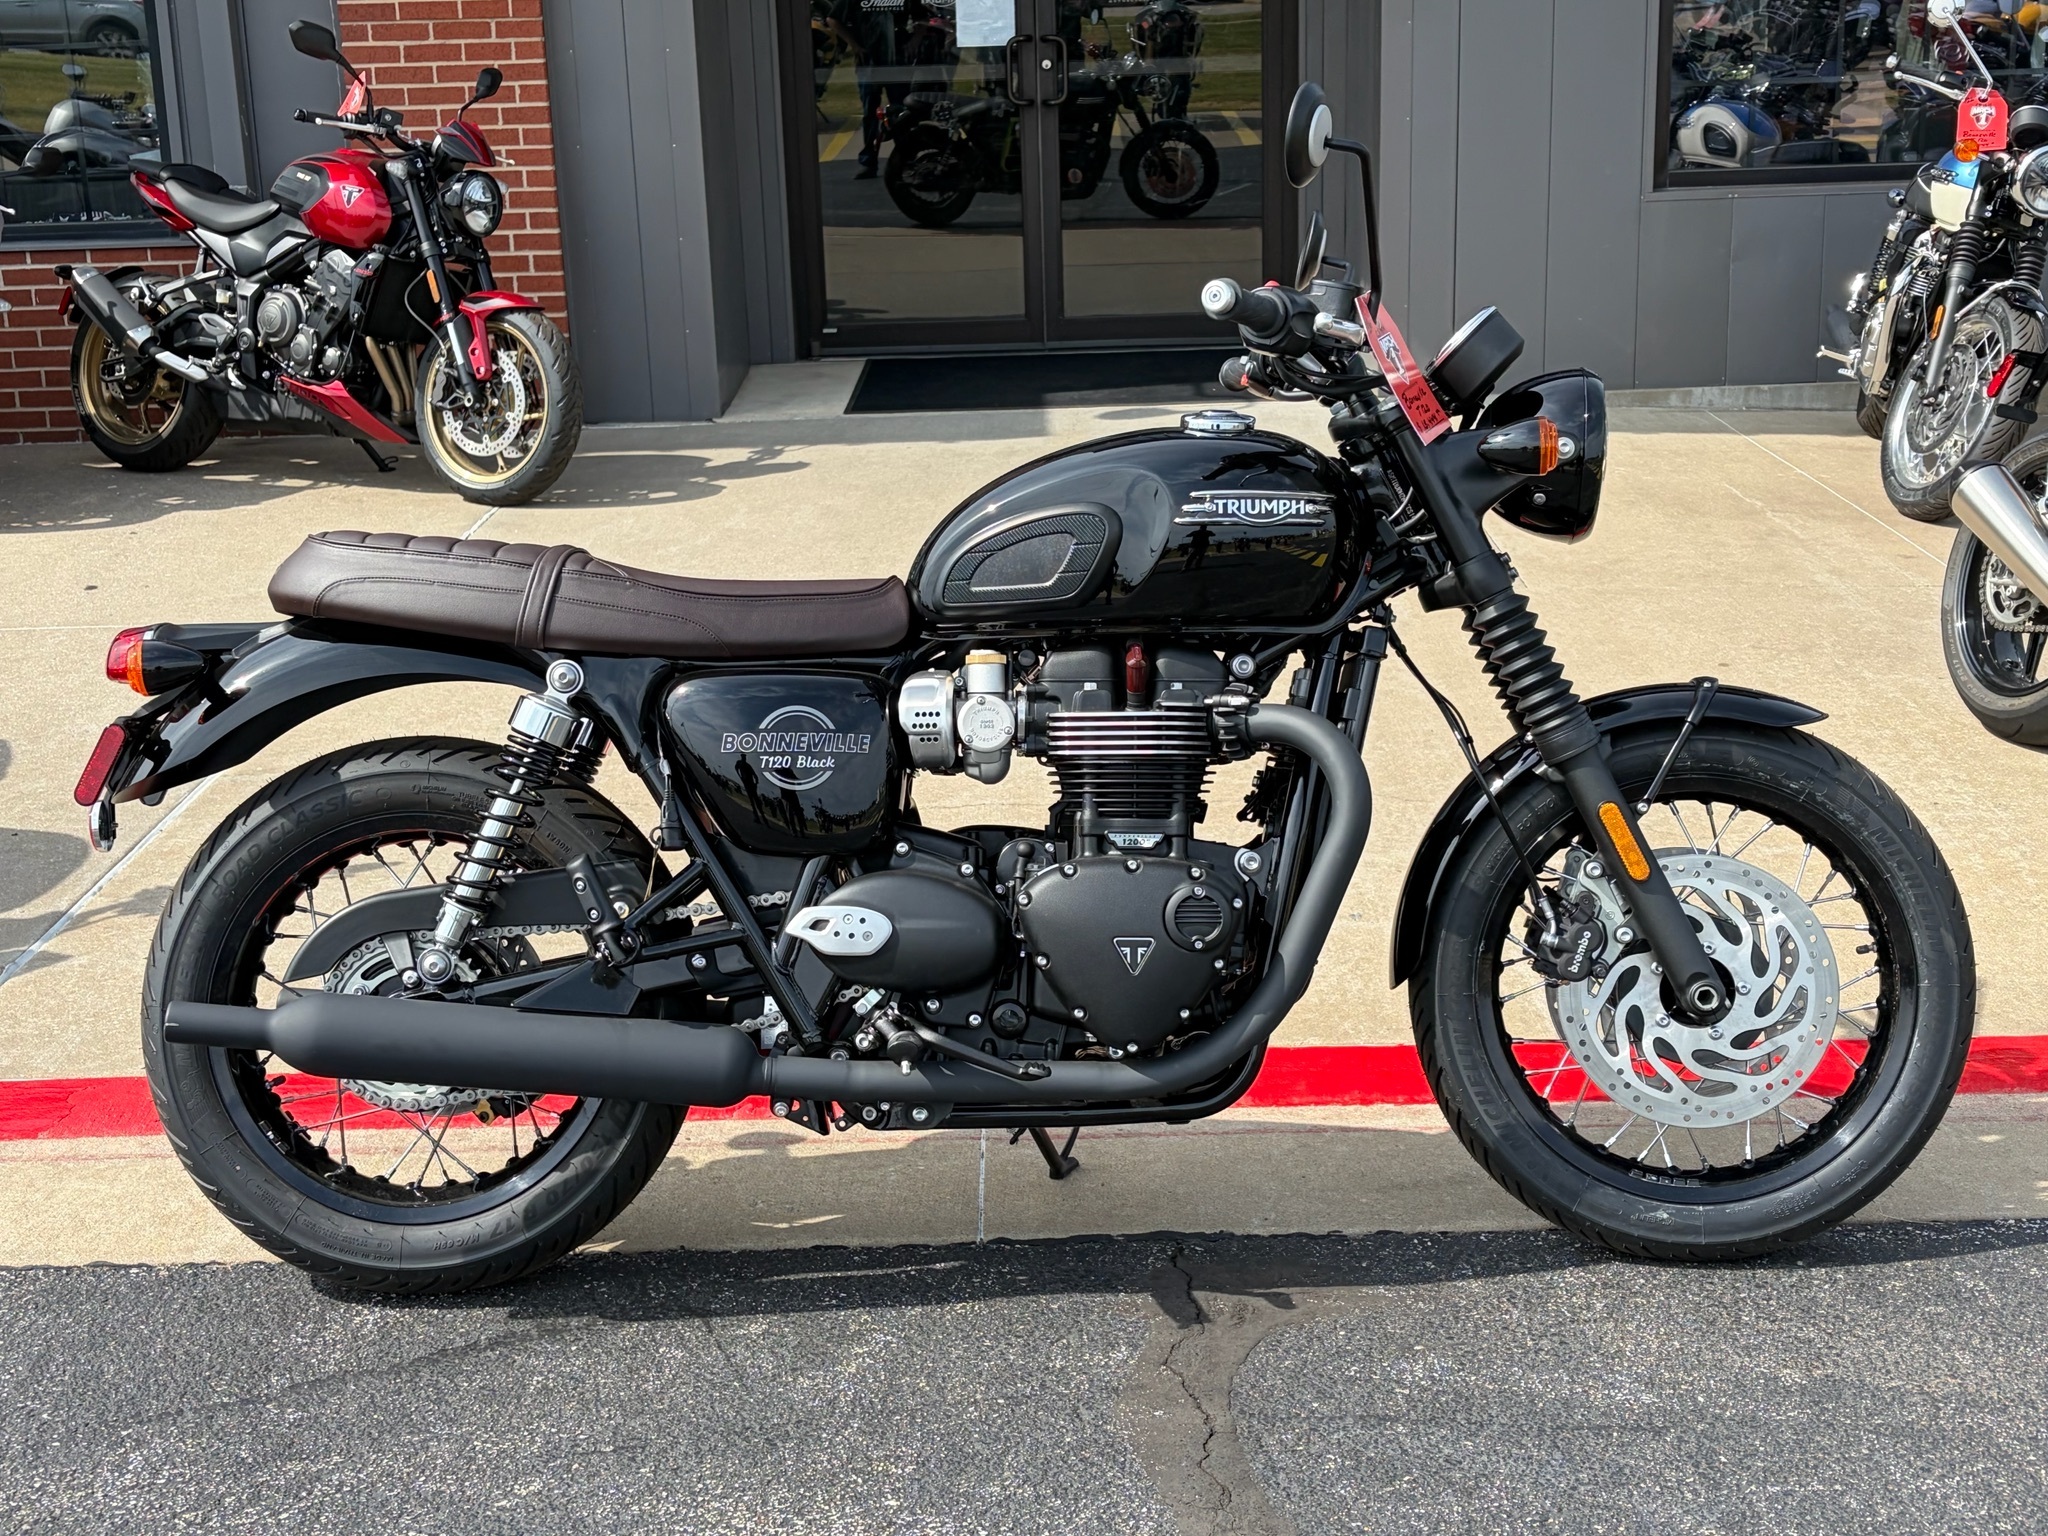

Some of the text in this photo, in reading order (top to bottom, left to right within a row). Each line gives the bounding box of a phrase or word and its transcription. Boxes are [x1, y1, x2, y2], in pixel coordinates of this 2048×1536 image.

[1213, 498, 1305, 518] TRIUMPH
[720, 731, 871, 754] BONNEVILLE
[759, 755, 836, 769] T120 Black
[212, 787, 364, 903] ROAD CLASSIC
[1122, 838, 1146, 846] 1200
[1868, 827, 1944, 955] MICHELIN
[1567, 930, 1593, 976] brembo
[1449, 1018, 1522, 1147] MICHELIN
